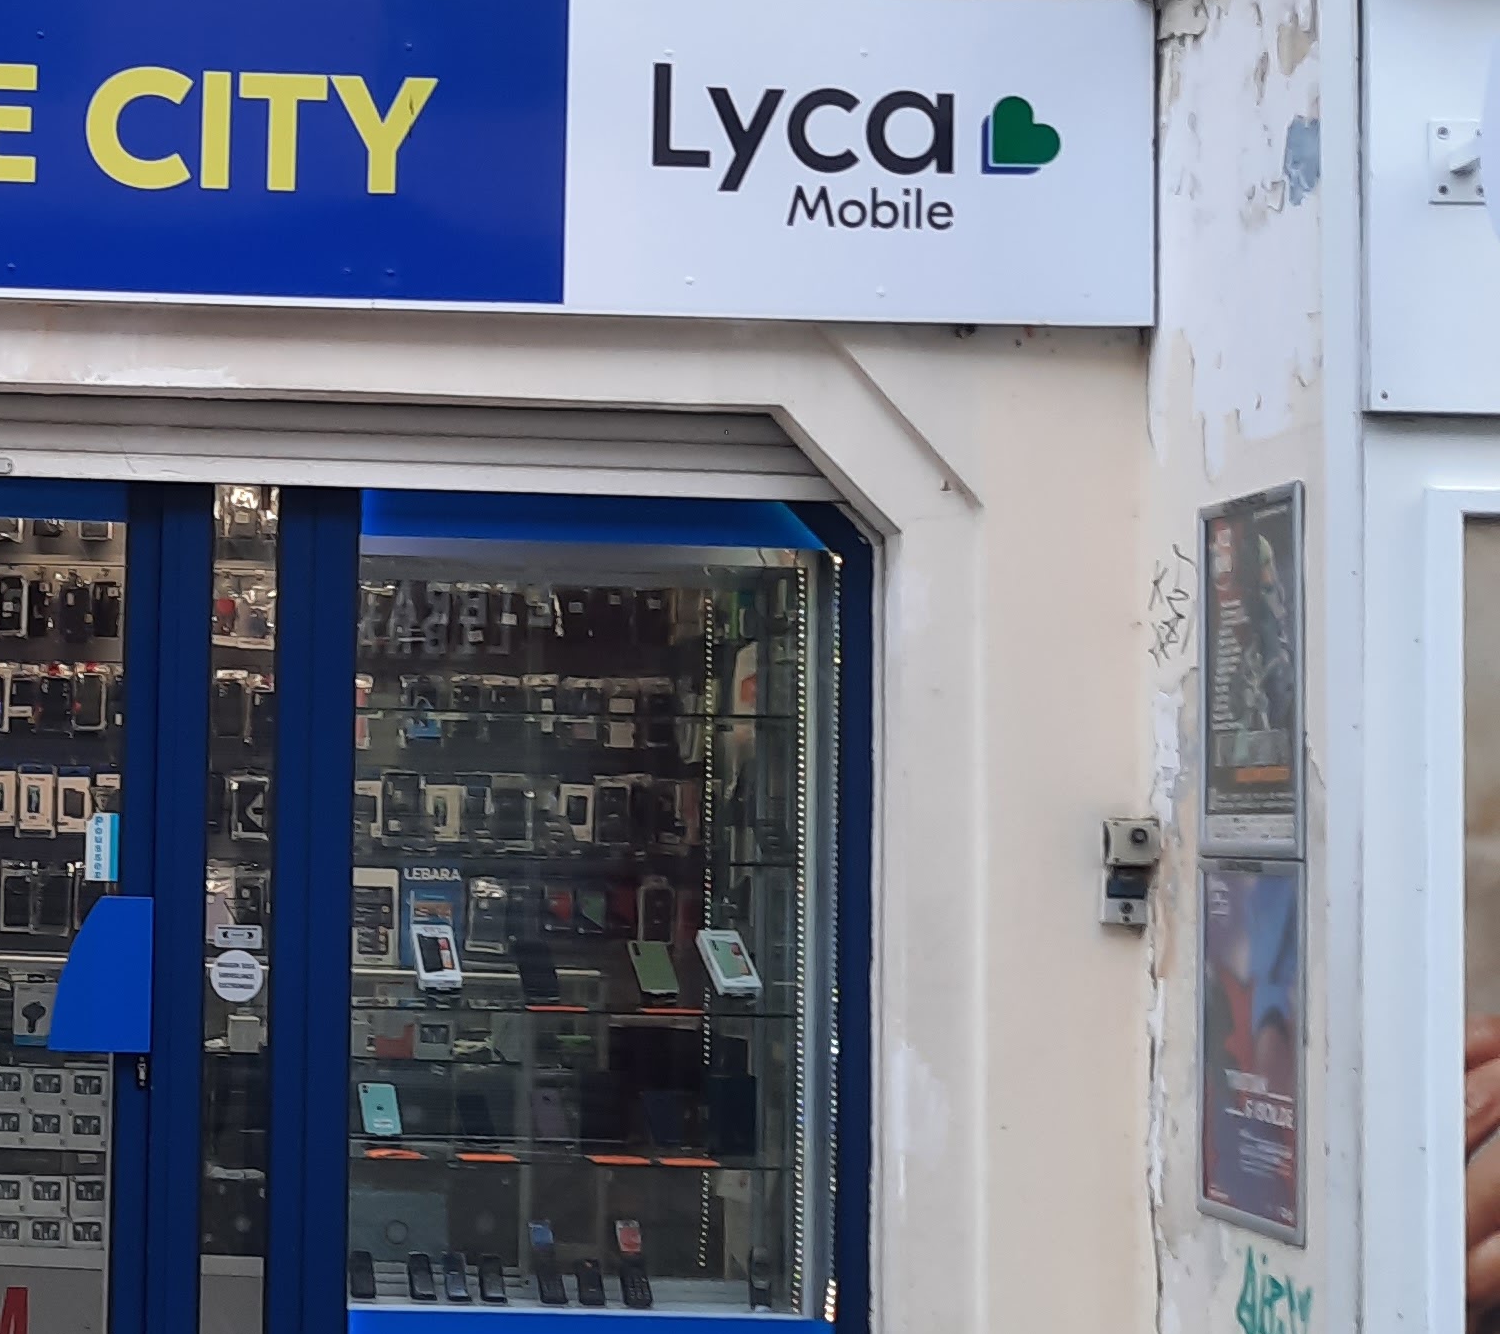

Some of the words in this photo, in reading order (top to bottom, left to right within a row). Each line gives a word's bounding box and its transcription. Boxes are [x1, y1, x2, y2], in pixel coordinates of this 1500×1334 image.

[85, 65, 438, 195] CITY
[652, 62, 955, 192] Lyca
[786, 185, 955, 232] Mobile
[403, 866, 462, 882] LEBARA
